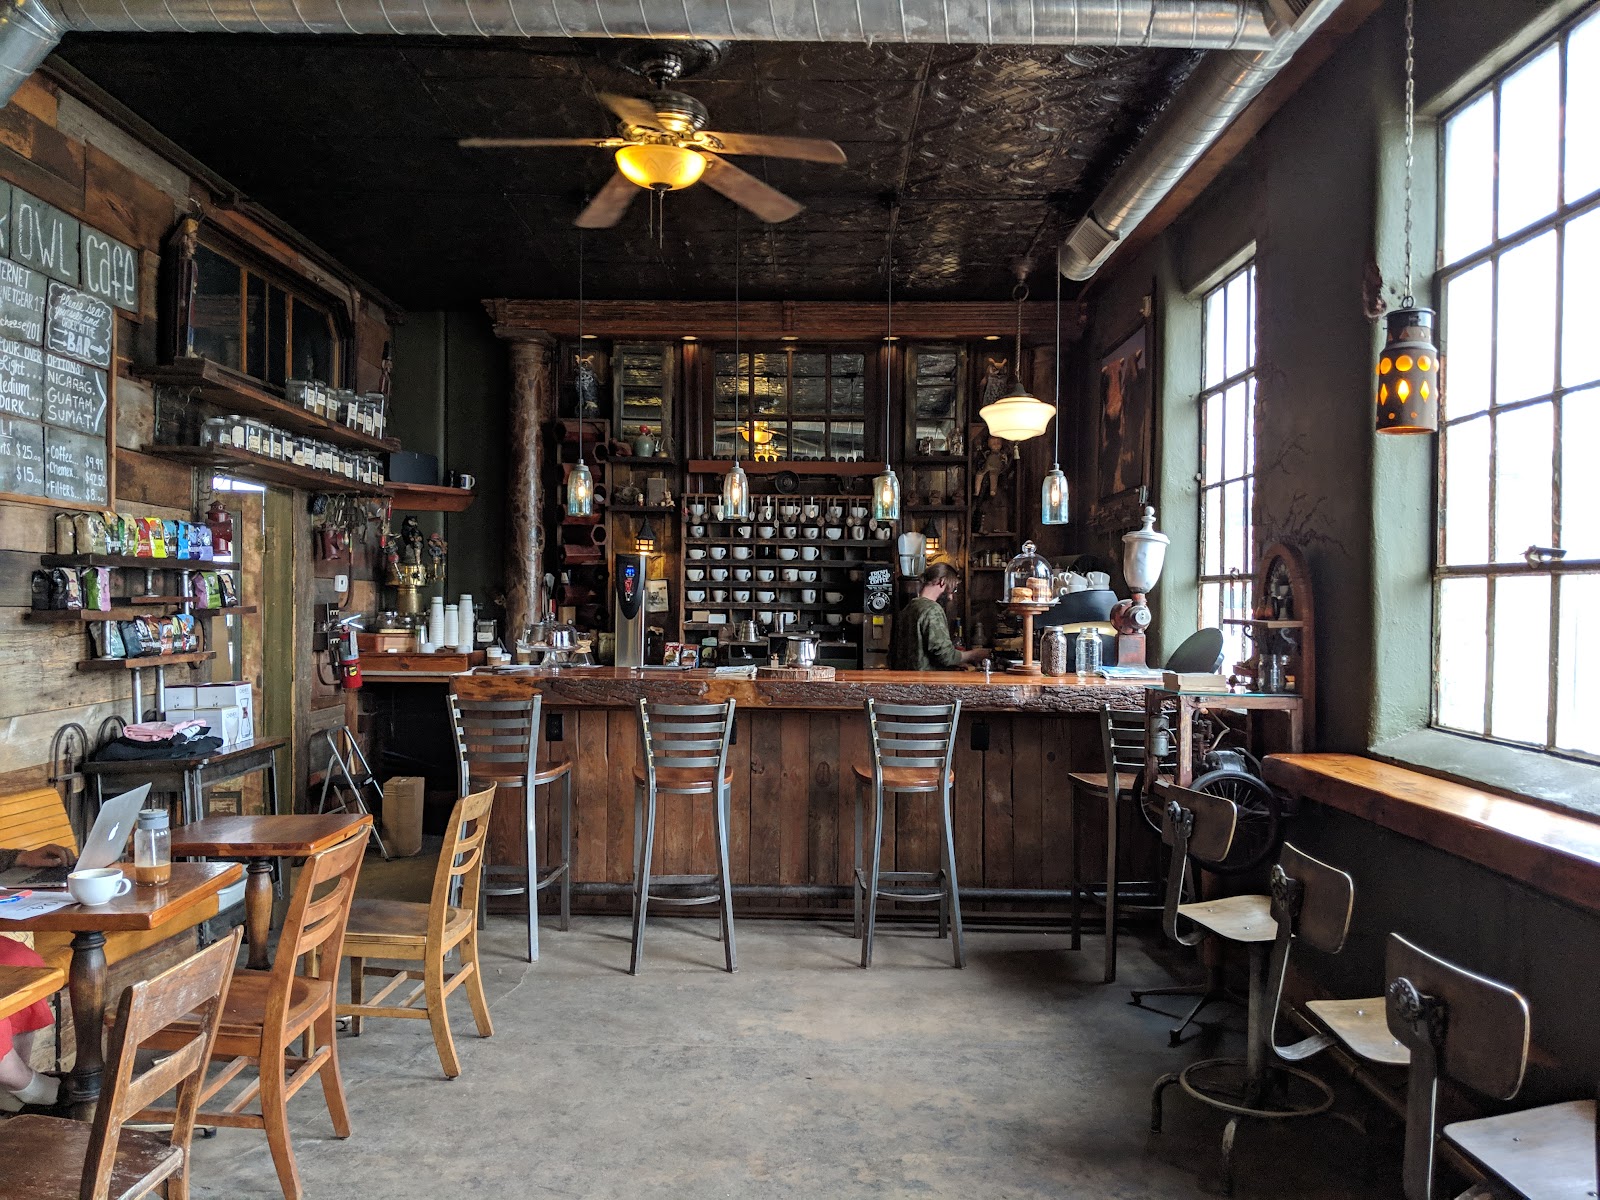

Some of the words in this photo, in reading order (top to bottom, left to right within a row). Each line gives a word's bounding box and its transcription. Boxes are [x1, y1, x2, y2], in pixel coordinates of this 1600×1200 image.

[19, 203, 70, 276] OWL
[58, 293, 85, 312] Please
[85, 303, 106, 320] seat
[24, 346, 42, 364] OVER
[67, 331, 91, 358] BAR
